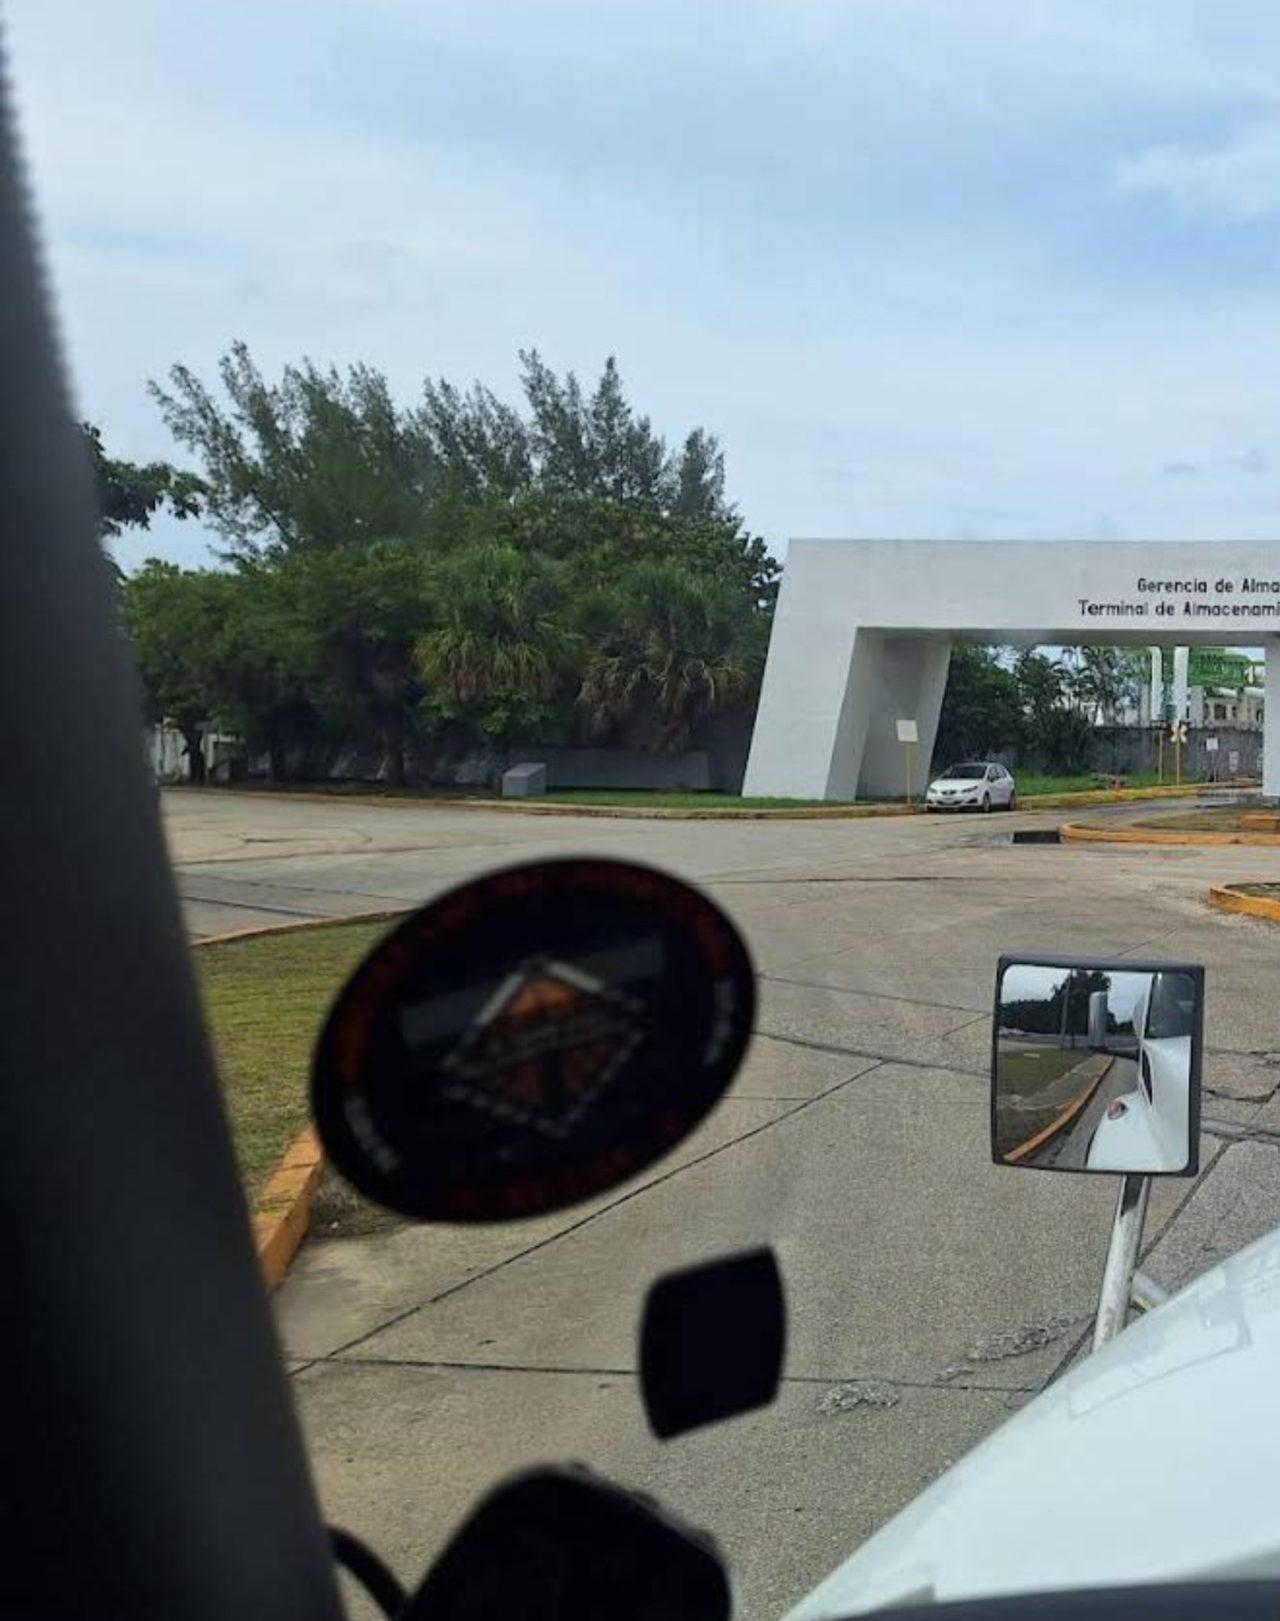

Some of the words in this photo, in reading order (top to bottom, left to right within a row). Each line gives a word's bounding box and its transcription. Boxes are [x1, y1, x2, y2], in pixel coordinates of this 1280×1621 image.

[1137, 578, 1207, 594] Gerencia
[1215, 578, 1233, 594] de
[1078, 600, 1149, 616] Terminal
[1155, 601, 1175, 617] de
